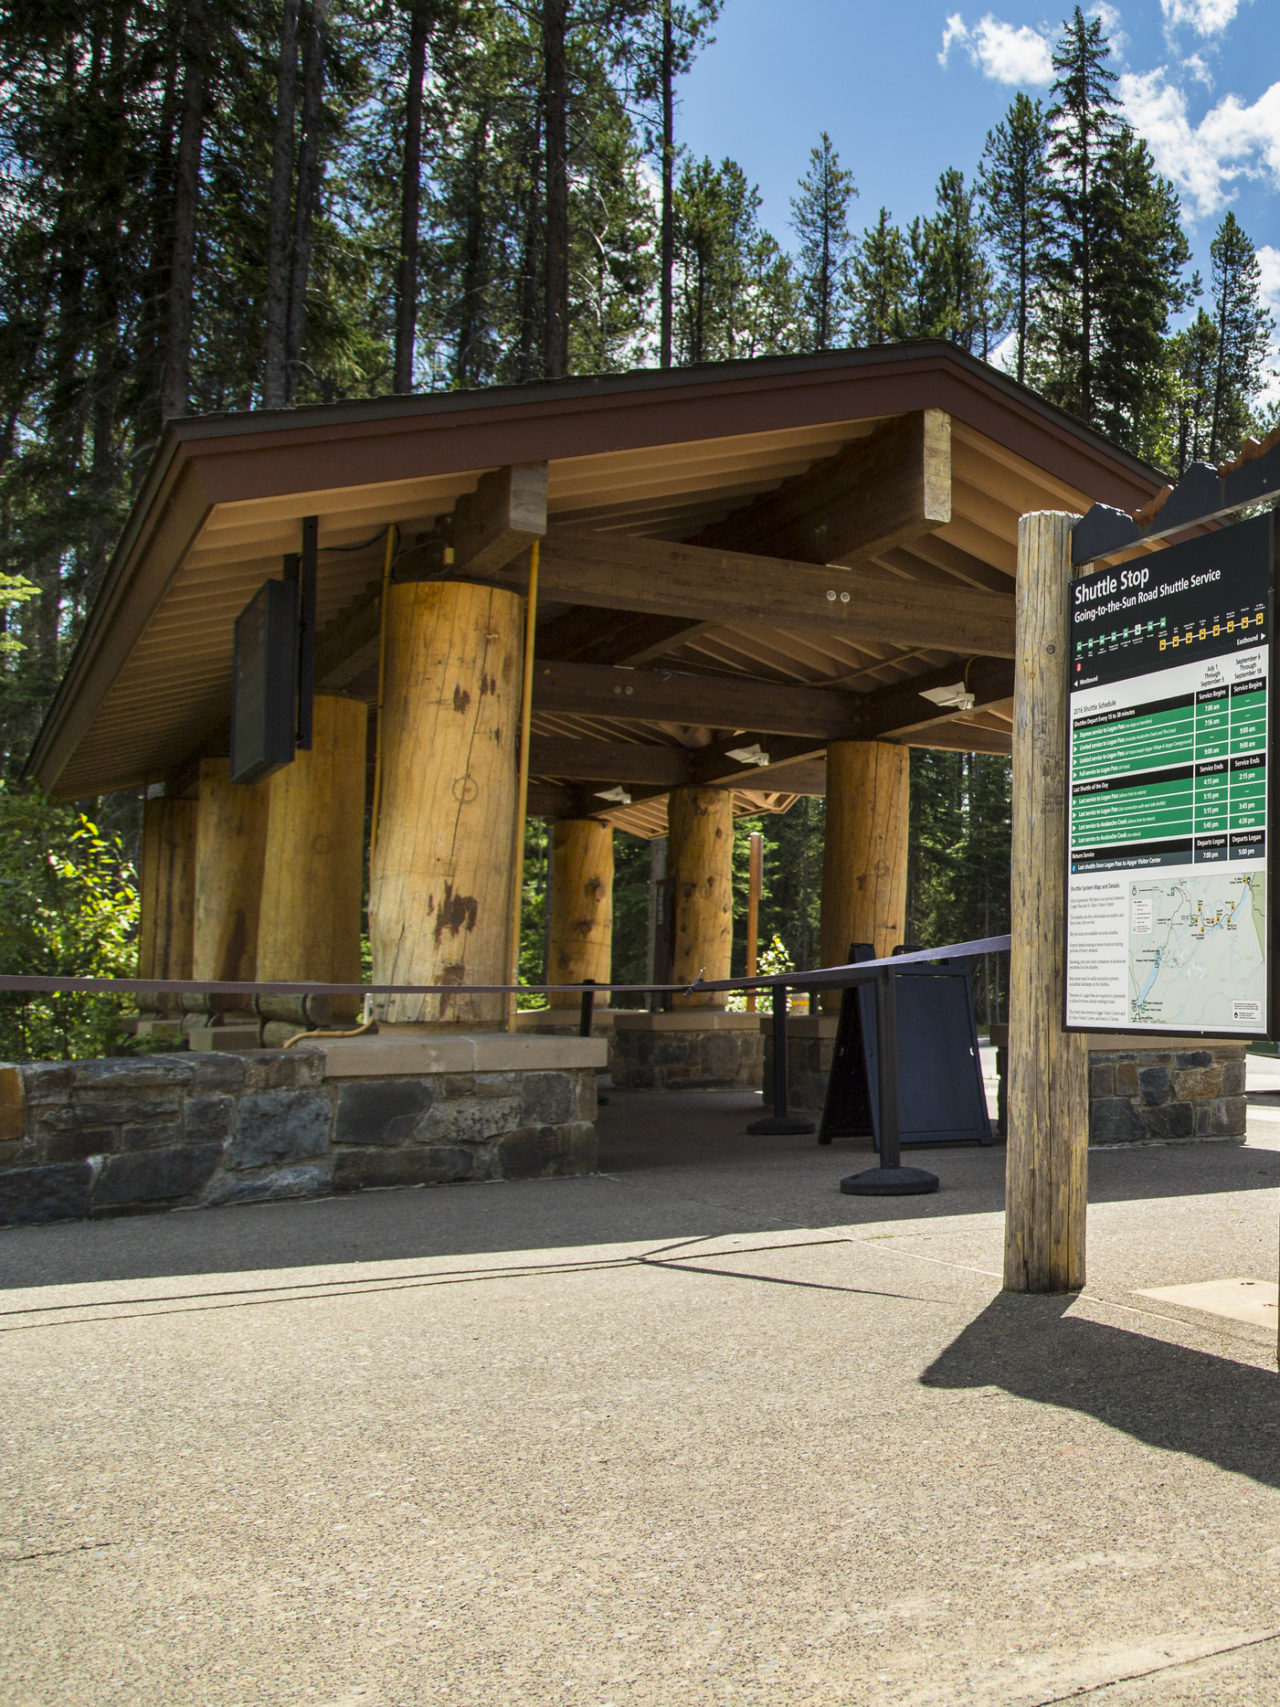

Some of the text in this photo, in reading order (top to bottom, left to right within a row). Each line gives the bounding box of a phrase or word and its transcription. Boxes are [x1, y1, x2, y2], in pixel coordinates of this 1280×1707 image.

[1075, 567, 1149, 604] Shuttle Stop
[1074, 596, 1136, 623] Going-to-the-Sun
[1138, 587, 1158, 604] Road
[1160, 578, 1188, 598] Shuttle
[1190, 568, 1221, 587] Service
[1236, 634, 1258, 646] Eastbound
[1236, 654, 1257, 665] September
[1240, 663, 1257, 671] Through
[1205, 670, 1220, 679] Through
[1234, 669, 1256, 680] September
[1201, 678, 1221, 688] September
[1234, 681, 1262, 693] Service Begins
[1199, 689, 1226, 700] Service Begins
[1084, 703, 1097, 712] Shuttle
[1098, 700, 1116, 710] Schedule
[1200, 764, 1213, 772] Service
[1235, 758, 1249, 767] Service
[1197, 838, 1225, 847] Departs Logan
[1232, 834, 1261, 844] Departs Logan
